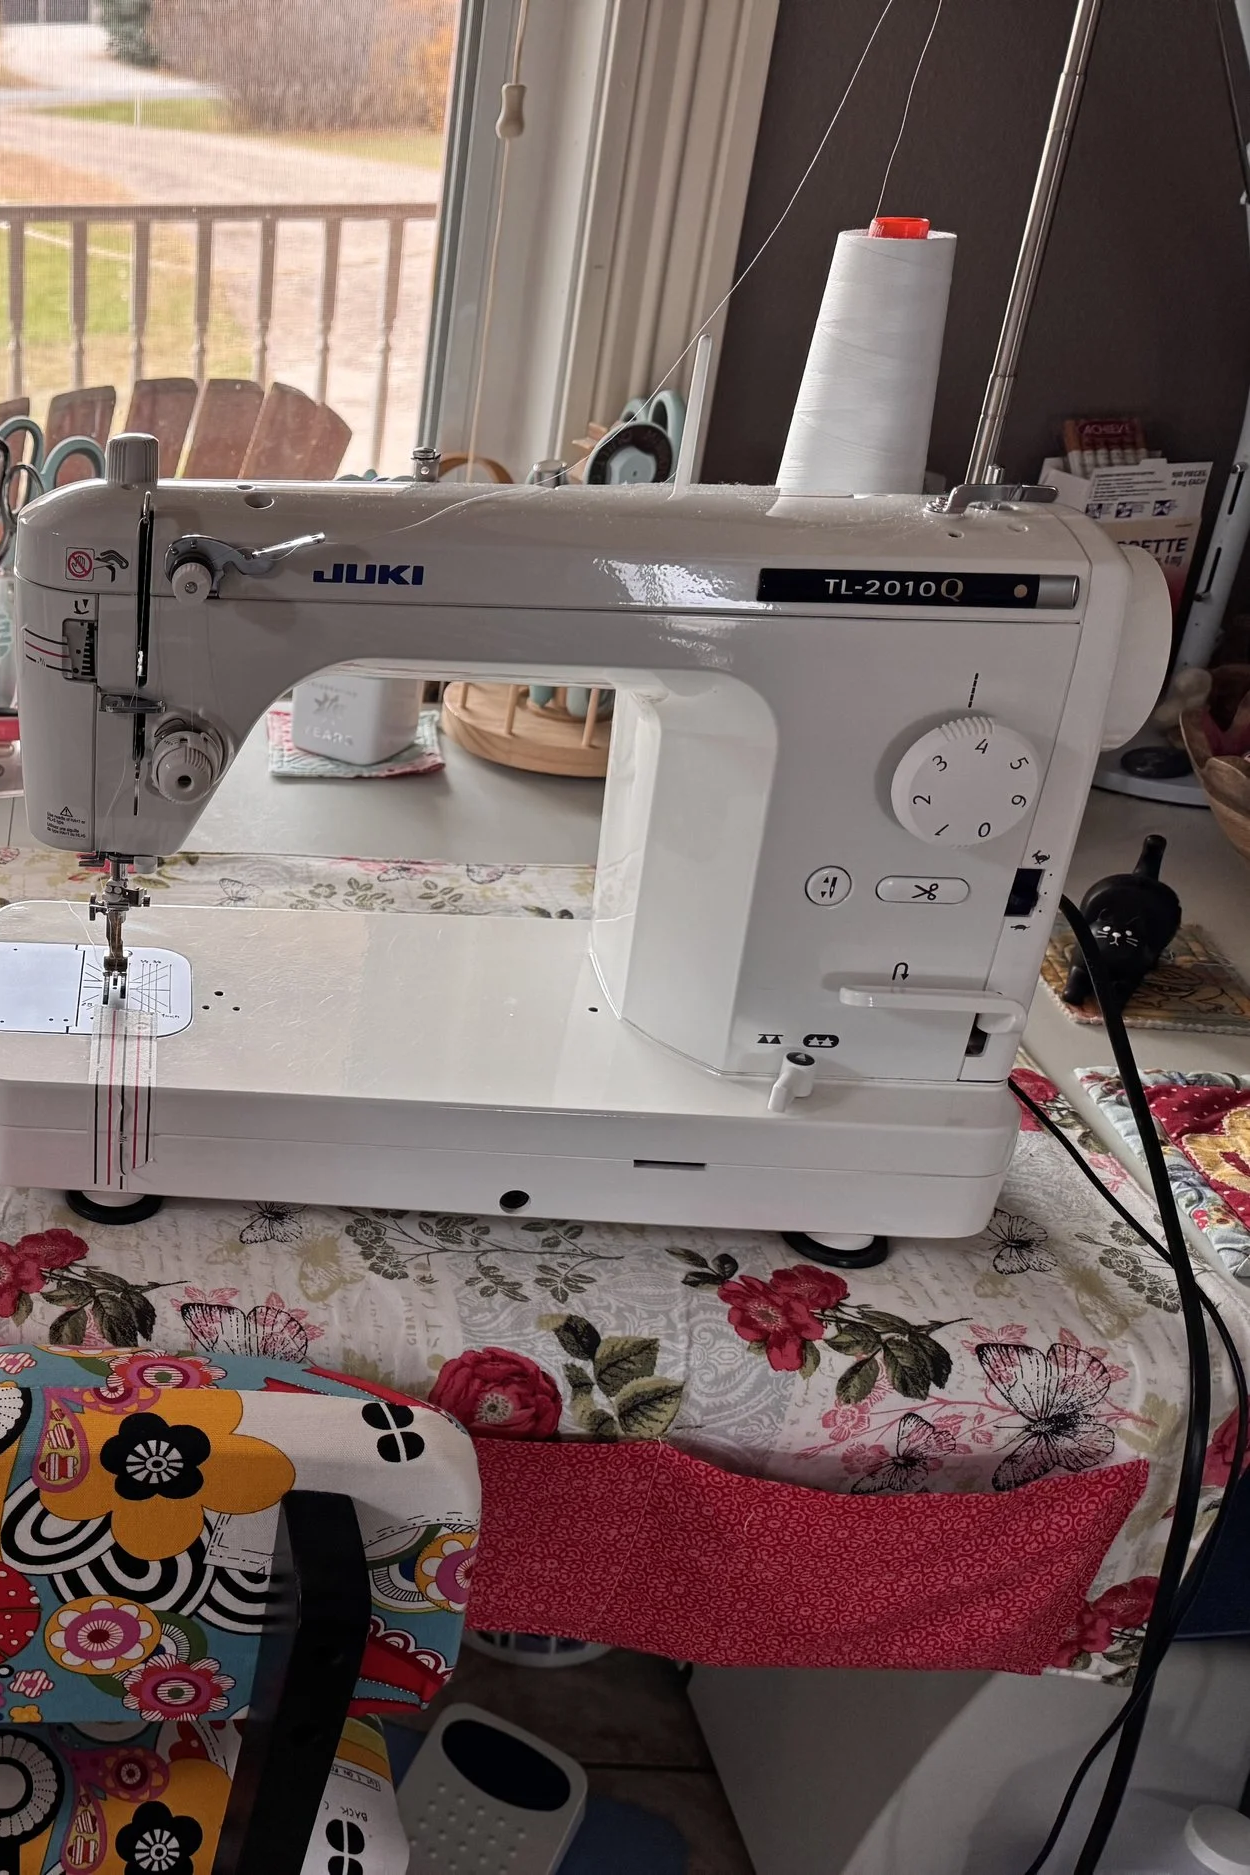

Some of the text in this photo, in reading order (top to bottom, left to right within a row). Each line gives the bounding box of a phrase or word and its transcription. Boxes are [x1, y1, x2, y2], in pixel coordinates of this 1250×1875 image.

[313, 563, 424, 585] JUKI
[825, 578, 964, 602] TL-2010Q
[975, 739, 989, 754] 4
[932, 755, 1029, 772] 3 5
[912, 795, 1027, 808] 2 6
[934, 822, 991, 837] 1 0
[340, 1806, 368, 1822] BACK
